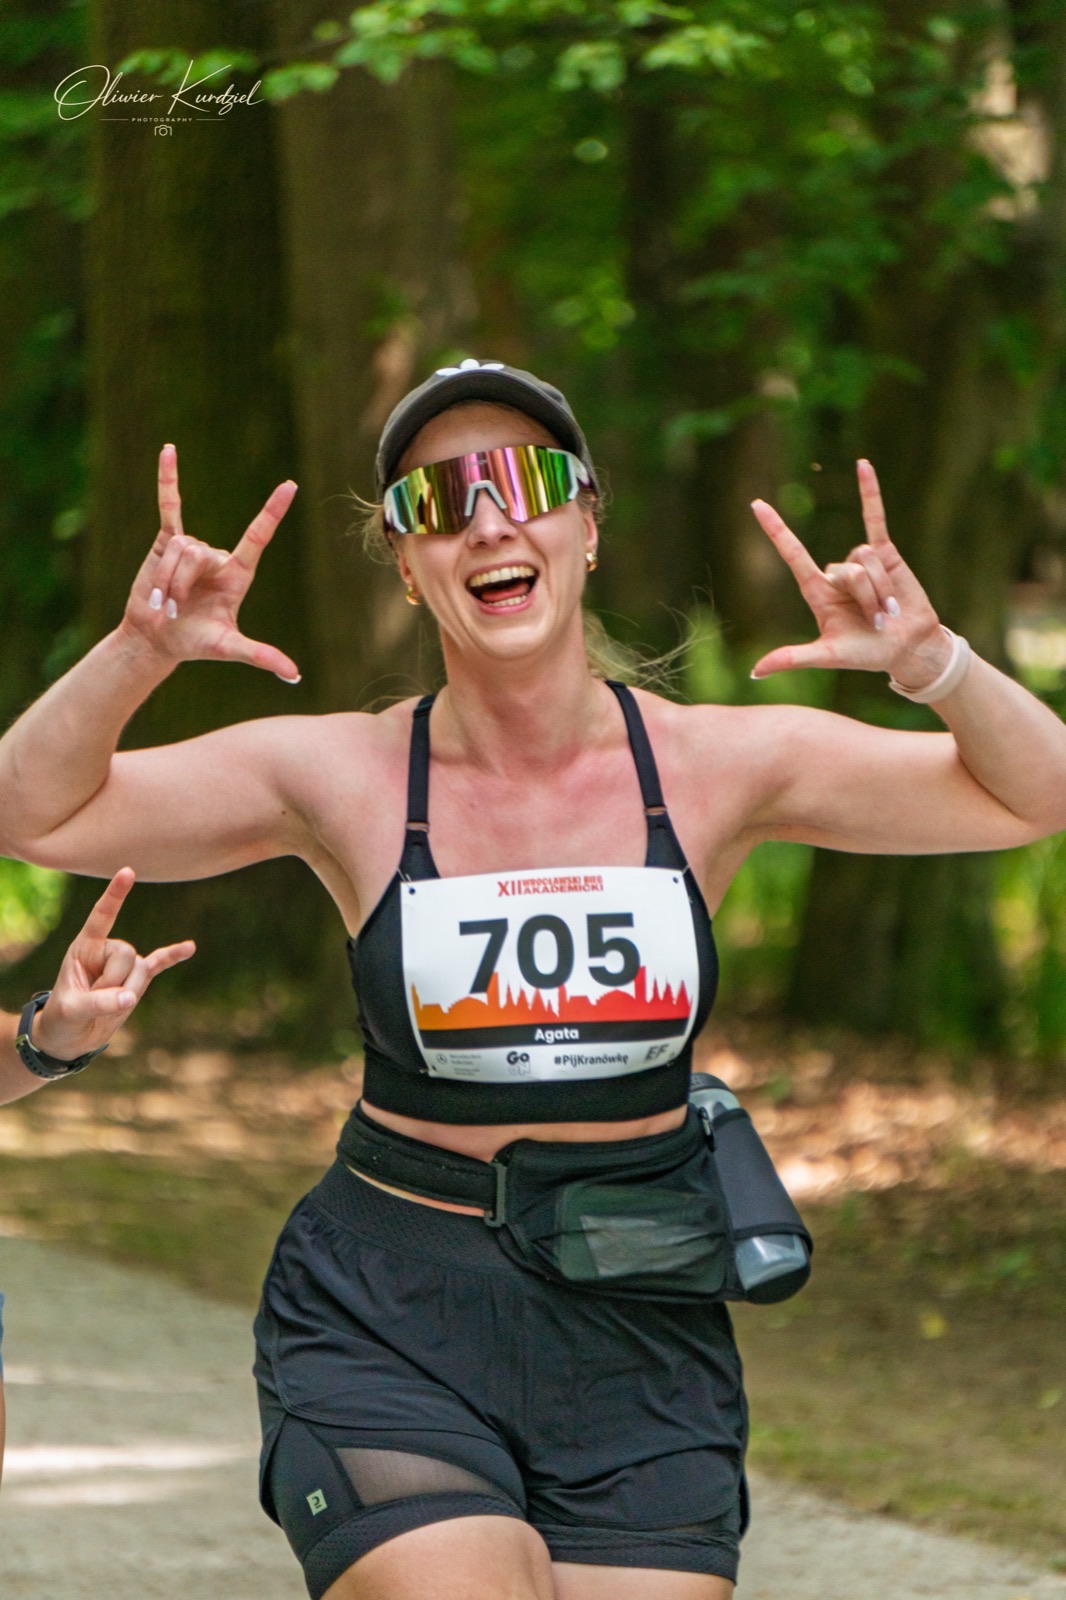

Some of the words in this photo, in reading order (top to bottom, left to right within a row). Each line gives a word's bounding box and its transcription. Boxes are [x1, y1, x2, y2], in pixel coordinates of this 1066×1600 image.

[497, 880, 522, 897] XII
[523, 884, 604, 895] AKADEMICKI
[459, 912, 641, 994] 705
[534, 1027, 579, 1044] Agata
